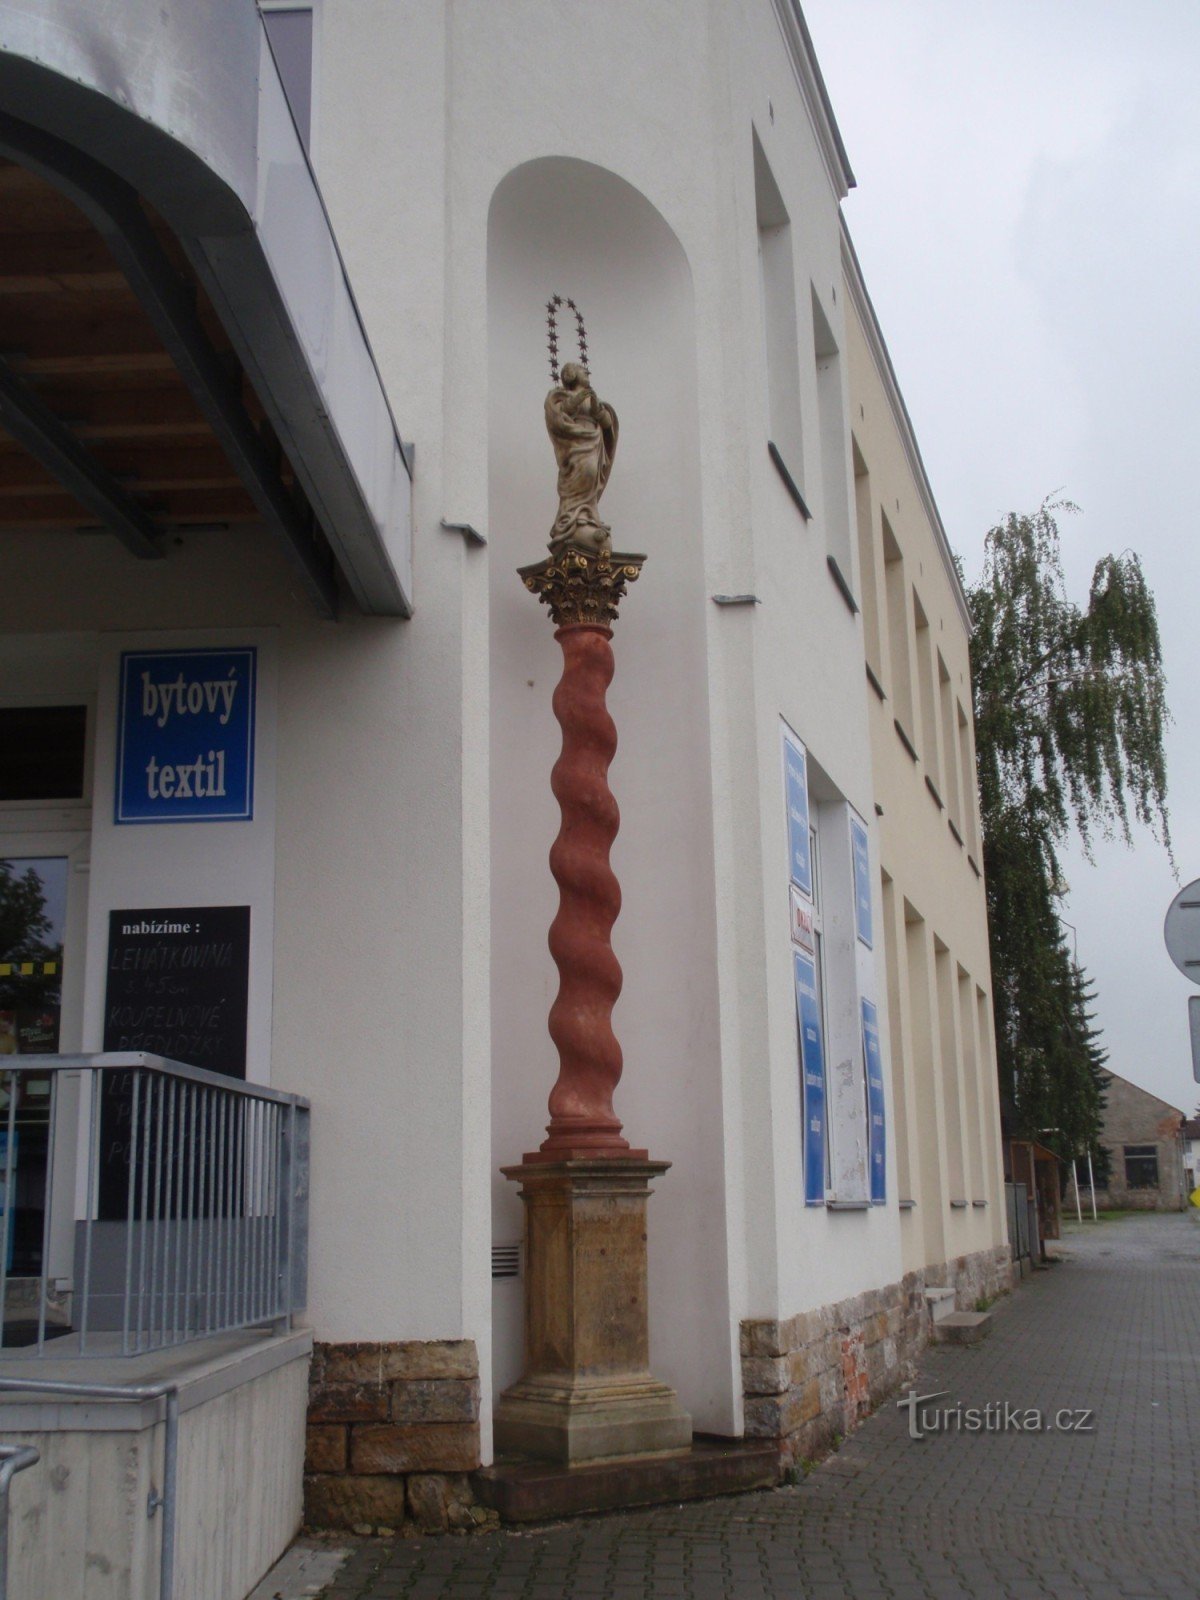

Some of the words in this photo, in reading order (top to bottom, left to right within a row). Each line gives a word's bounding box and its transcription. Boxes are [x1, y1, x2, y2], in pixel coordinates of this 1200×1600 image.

[141, 666, 238, 728] bytový
[145, 750, 227, 800] textil
[121, 920, 191, 935] nabízíme
